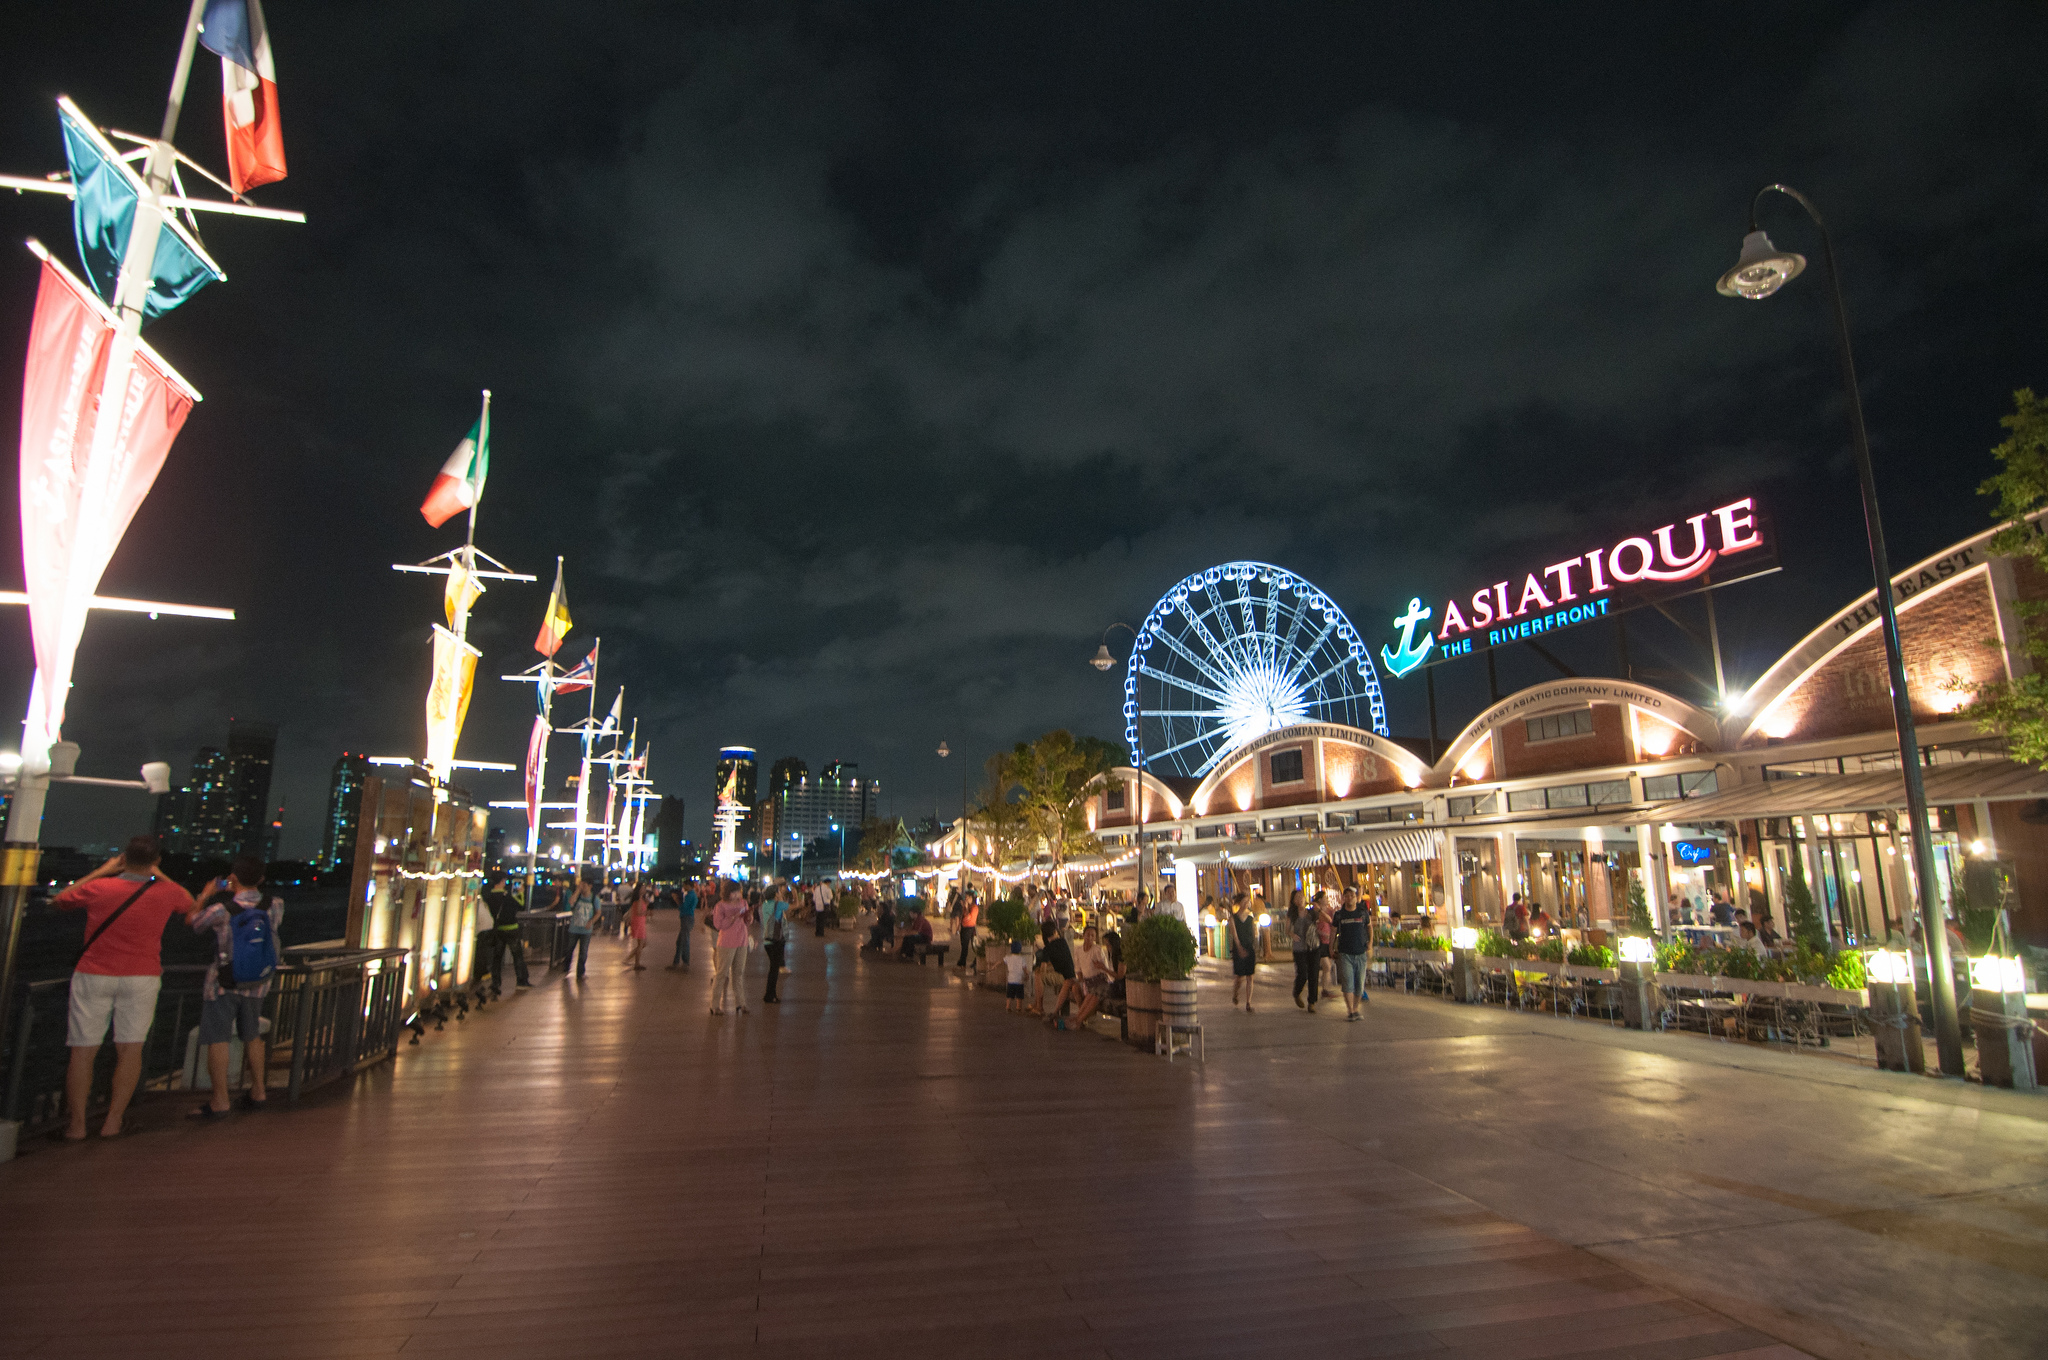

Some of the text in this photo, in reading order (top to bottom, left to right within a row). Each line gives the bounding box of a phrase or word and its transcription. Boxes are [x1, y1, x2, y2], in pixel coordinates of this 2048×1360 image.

[1437, 497, 1764, 641] ASIATIQUE
[1894, 548, 1974, 599] EAST
[1441, 597, 1610, 660] THE RIVERFRONT
[1469, 686, 1662, 738] THE EAST ASIATIC COMPANY LIMITED
[1215, 726, 1376, 779] THE EAST ASIATIC COMPANY LIMITED
